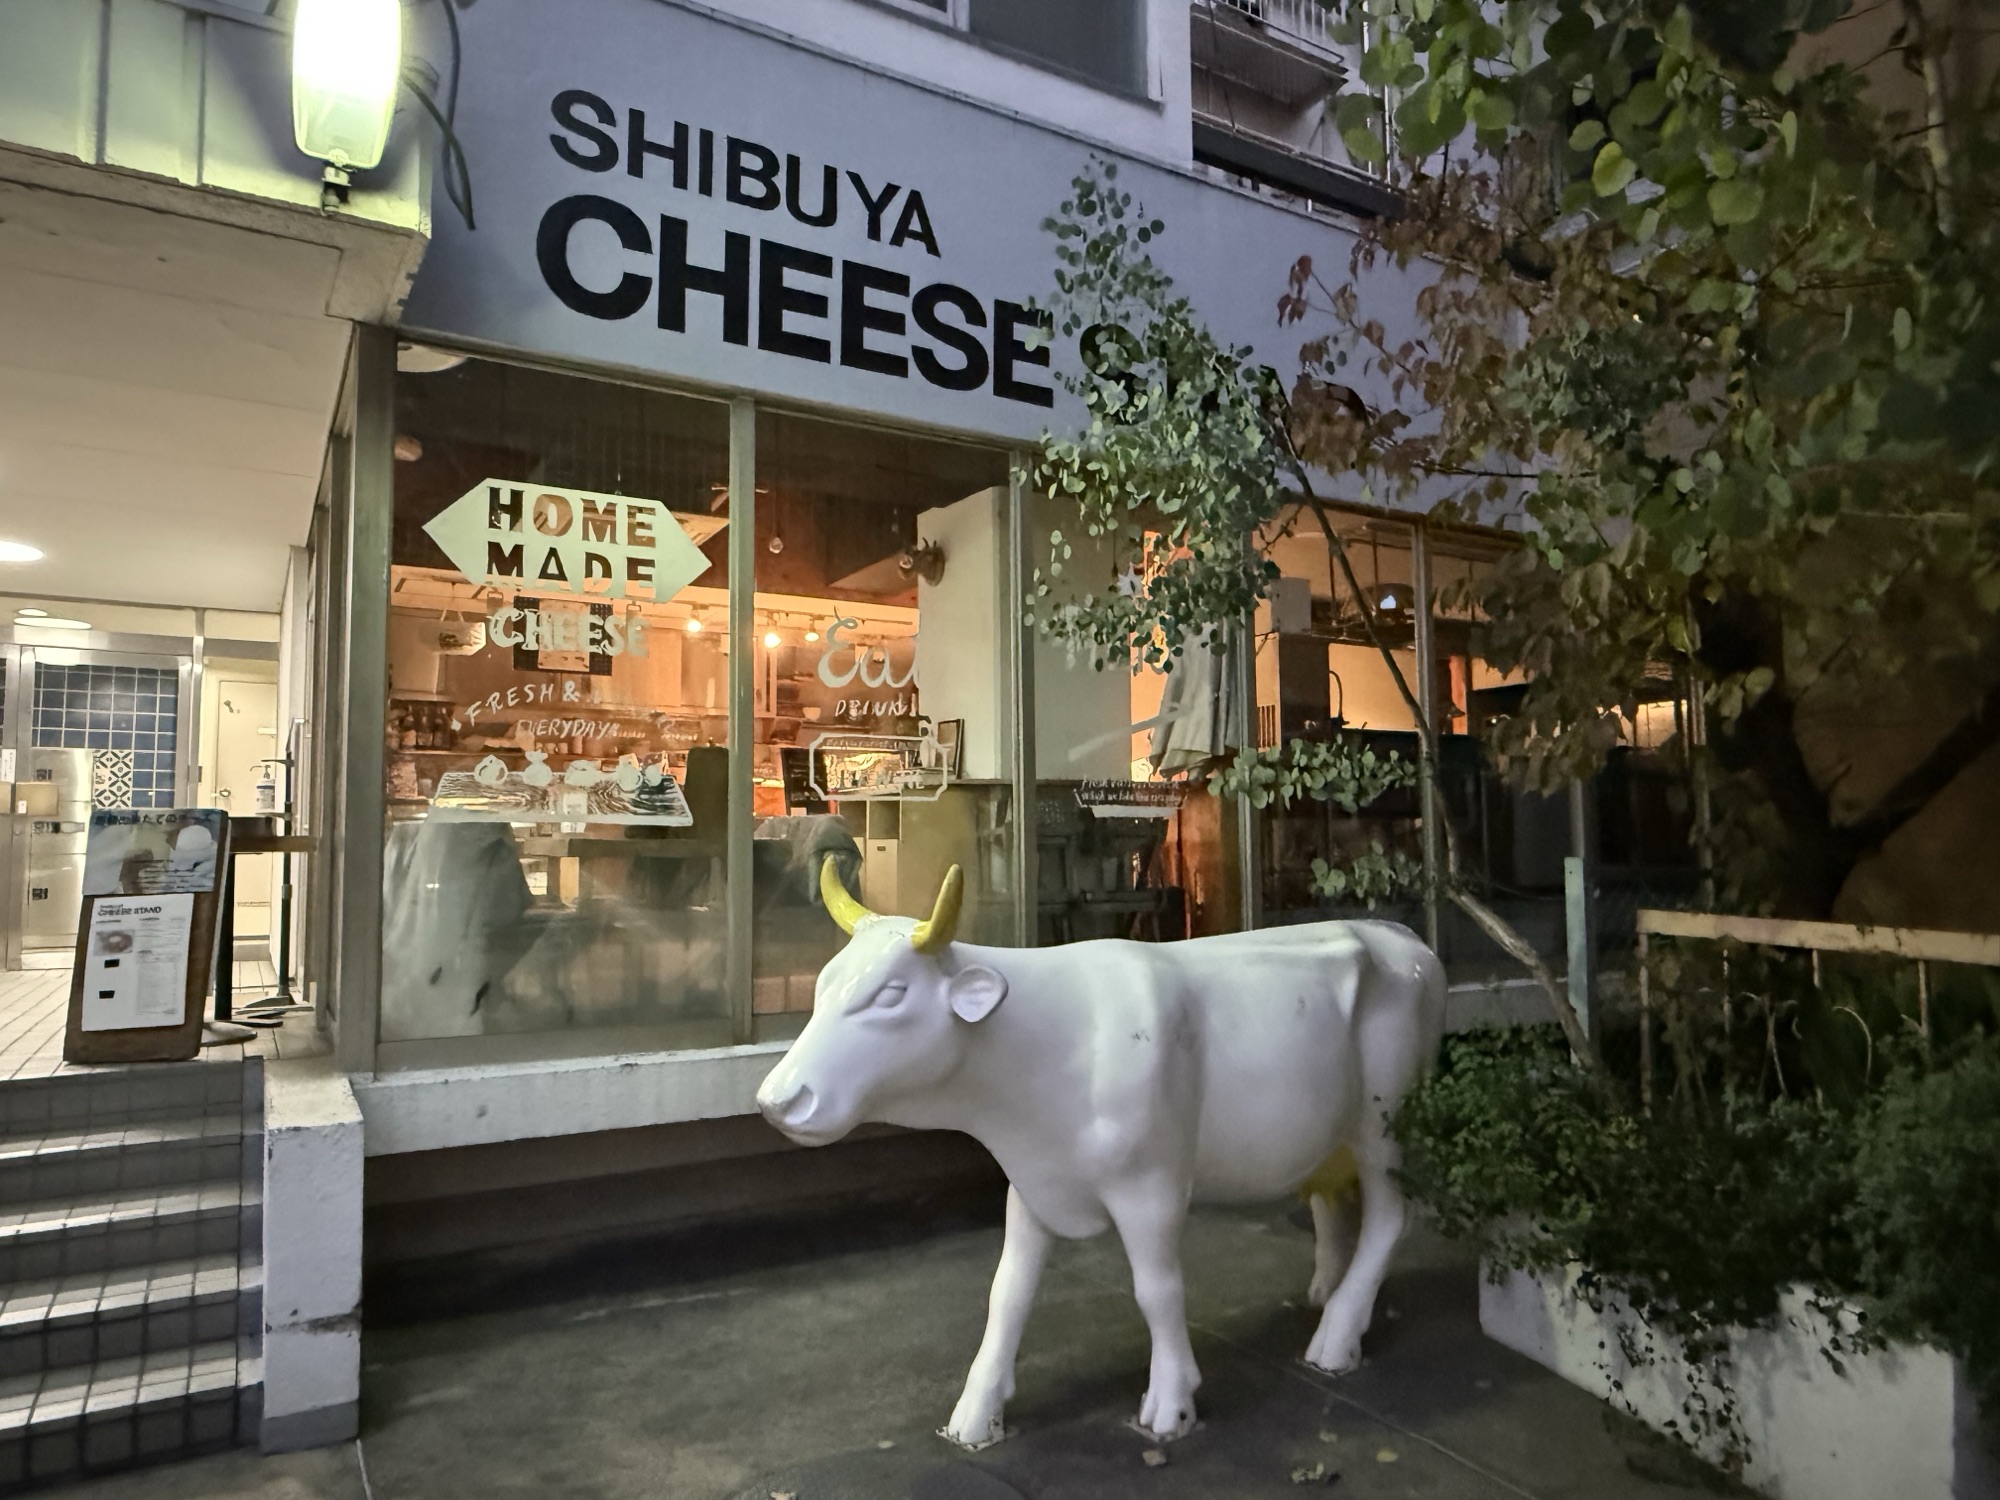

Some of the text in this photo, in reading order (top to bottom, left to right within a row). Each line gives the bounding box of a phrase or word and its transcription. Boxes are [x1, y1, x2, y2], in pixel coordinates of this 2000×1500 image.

[549, 89, 942, 258] SHIBUYA
[536, 194, 1054, 409] CHEESE
[487, 486, 657, 548] HOME
[487, 541, 657, 599] MADE
[488, 606, 651, 657] CHEESE
[465, 684, 554, 727] FRESH
[562, 680, 581, 703] &
